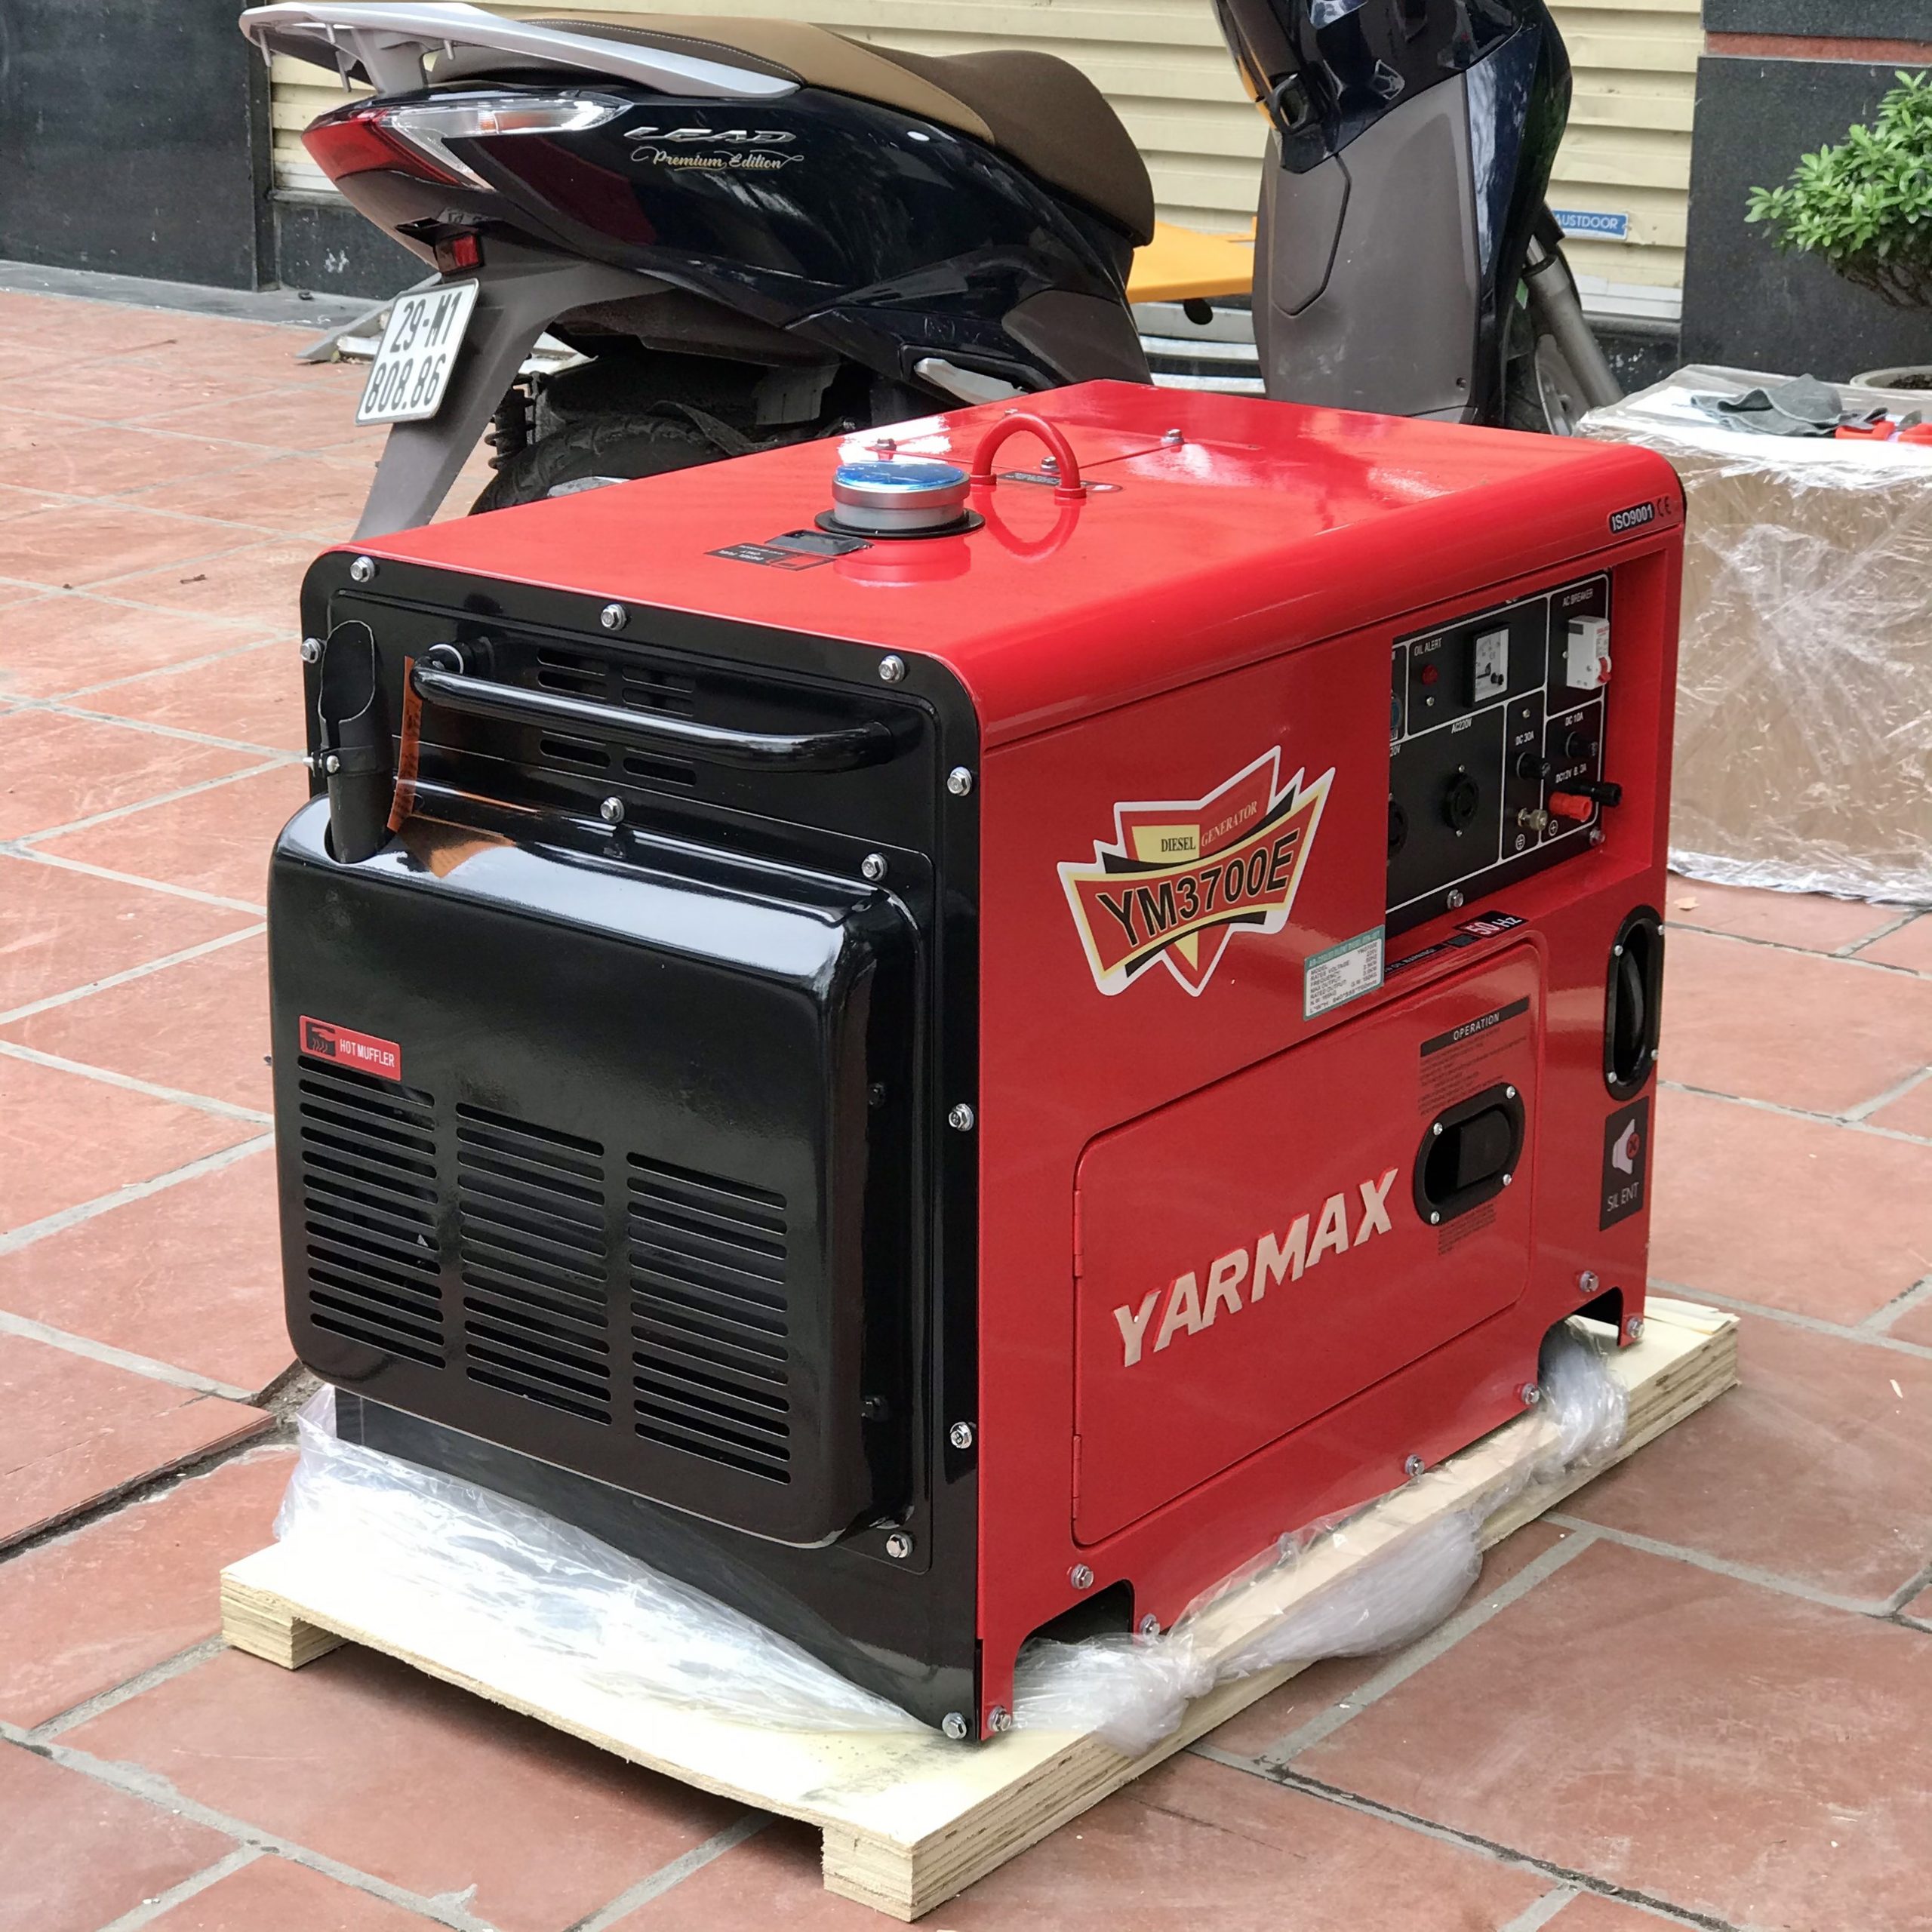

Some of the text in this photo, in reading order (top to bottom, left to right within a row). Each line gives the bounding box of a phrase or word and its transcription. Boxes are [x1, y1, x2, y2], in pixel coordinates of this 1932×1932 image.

[624, 126, 796, 143] LEAD
[641, 148, 789, 171] Premium Edition
[389, 291, 463, 353] 29-M1
[365, 353, 447, 414] 808.86
[1611, 503, 1653, 531] ISO9001
[1414, 638, 1442, 657] OIL ALERT
[1564, 715, 1573, 727] DC
[1515, 734, 1524, 746] DC
[1160, 800, 1258, 852] DIESEL GENERATOR
[1096, 828, 1301, 947] YM3700E
[1453, 1012, 1500, 1041] OPERATION
[339, 1038, 395, 1068] HOT MUFFLER
[1606, 1181, 1640, 1212] SILENT
[1112, 1168, 1398, 1367] YARMAX
